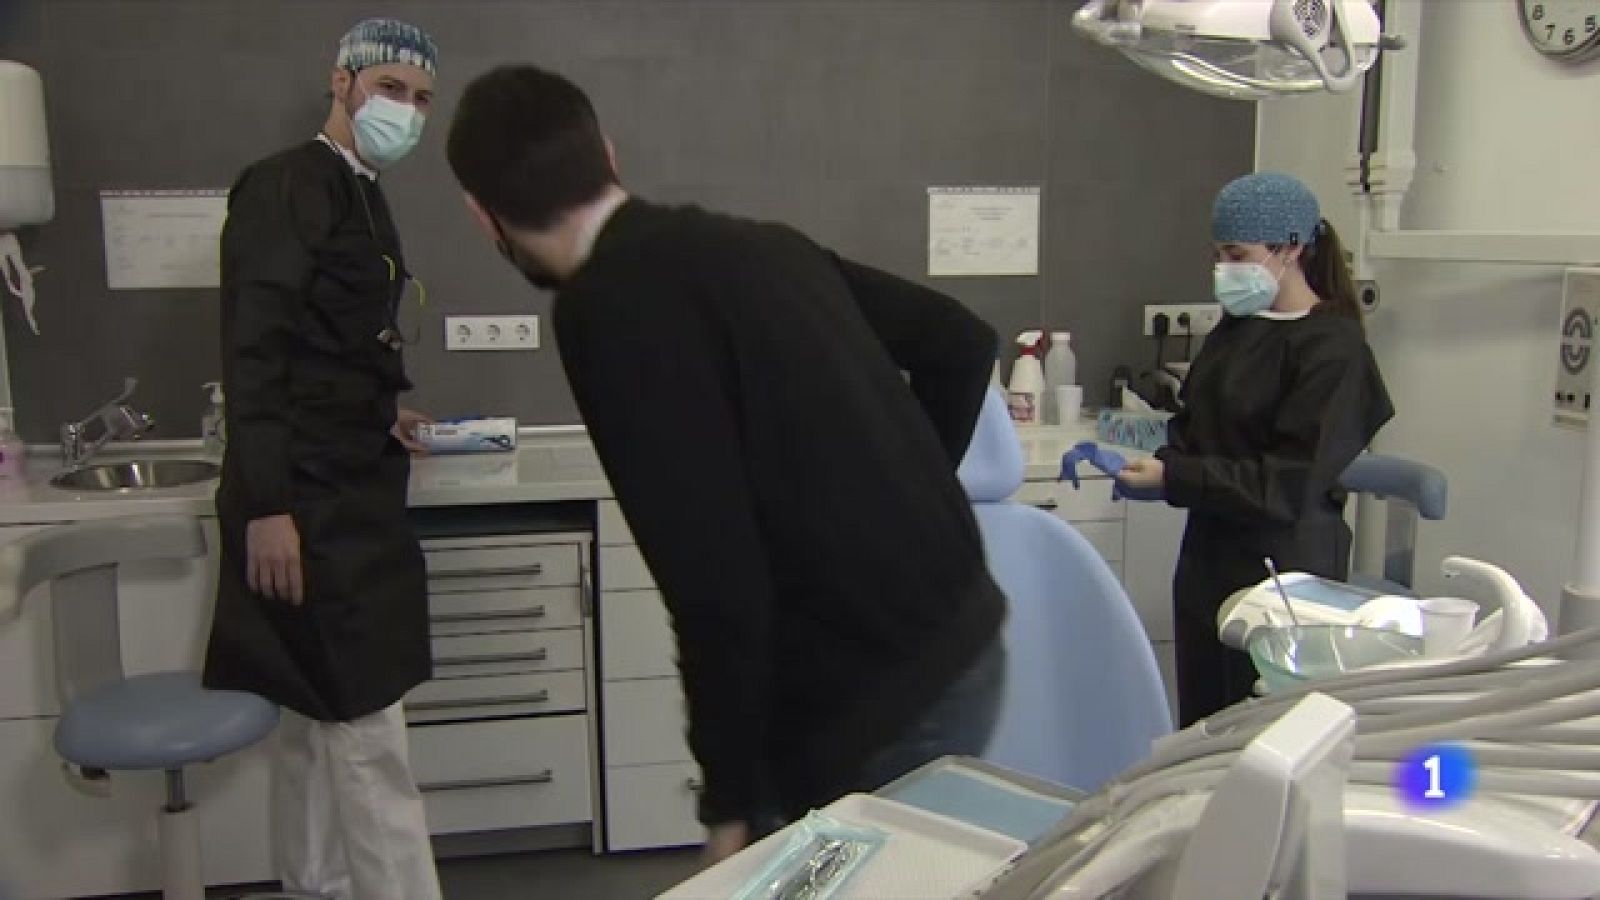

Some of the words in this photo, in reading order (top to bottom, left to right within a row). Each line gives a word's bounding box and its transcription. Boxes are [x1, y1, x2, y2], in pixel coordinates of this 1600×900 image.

[1533, 4, 1544, 20] 8
[1545, 24, 1556, 40] 7
[1563, 28, 1575, 46] 6
